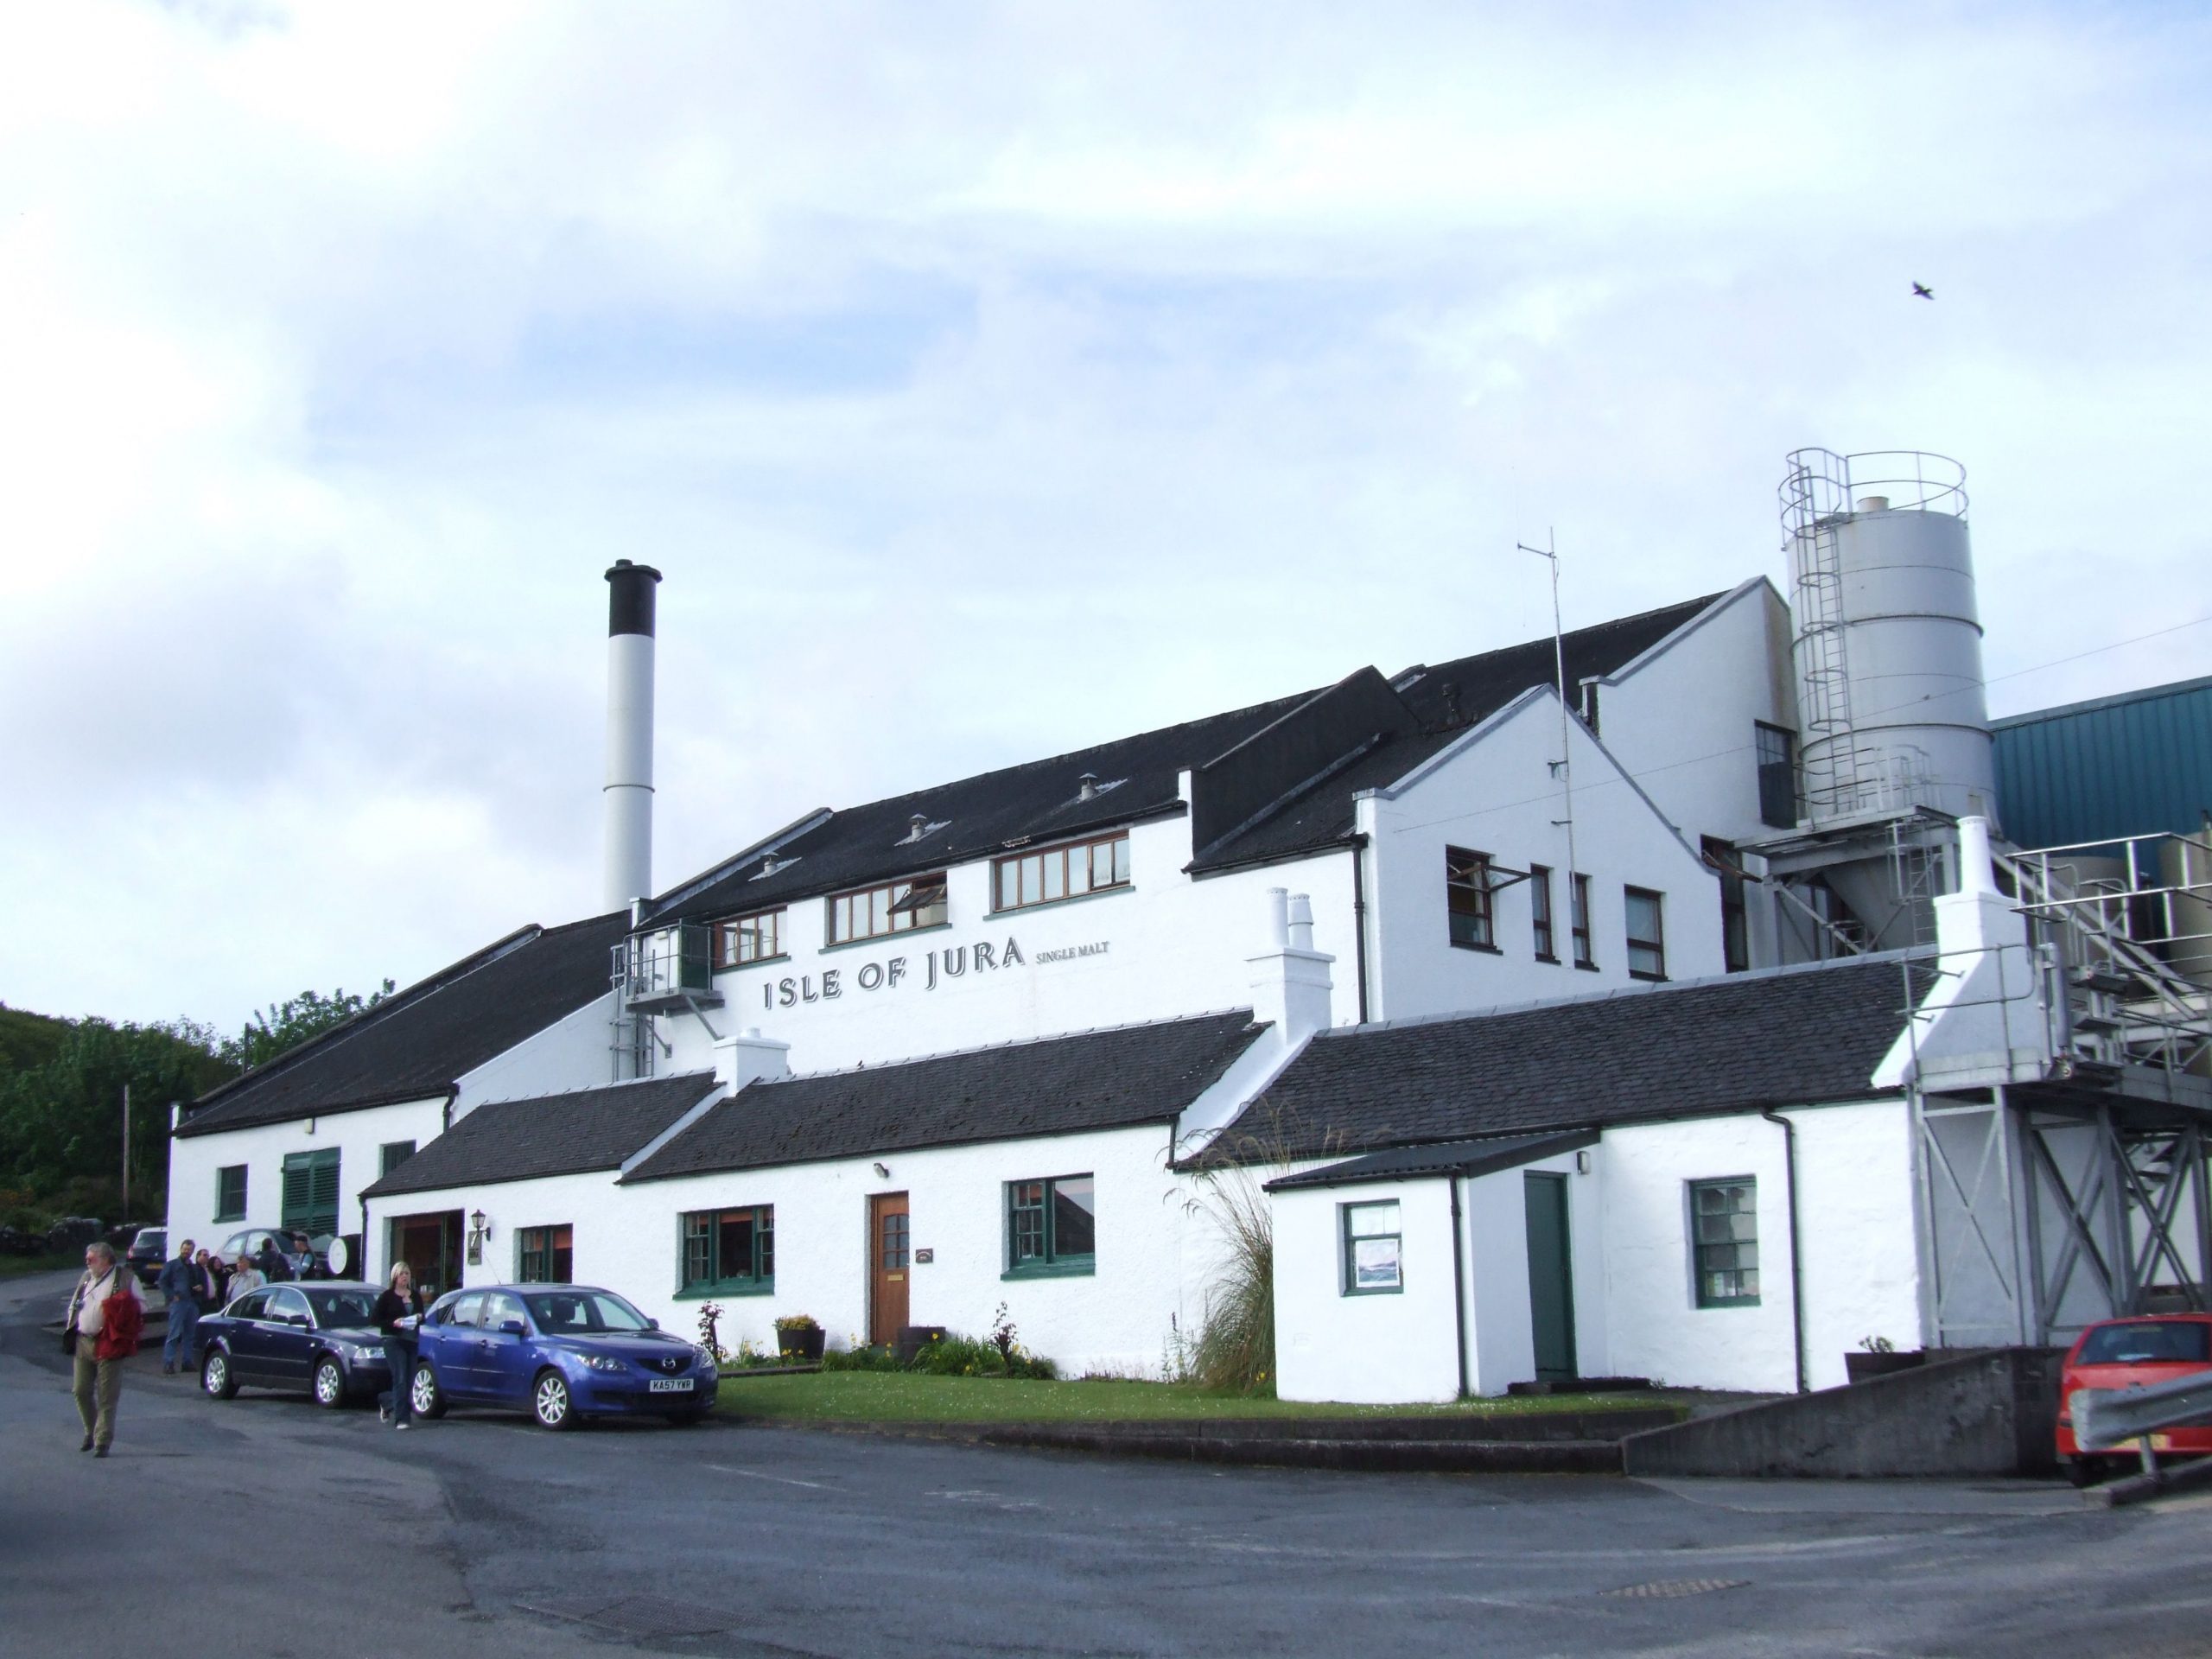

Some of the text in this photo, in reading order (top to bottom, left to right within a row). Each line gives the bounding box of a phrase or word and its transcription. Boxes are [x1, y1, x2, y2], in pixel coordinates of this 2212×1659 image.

[1036, 940, 1110, 964] SINGLE MALT
[763, 936, 1026, 1009] ISLE OF JURA
[653, 1380, 691, 1389] KA57 YWR
